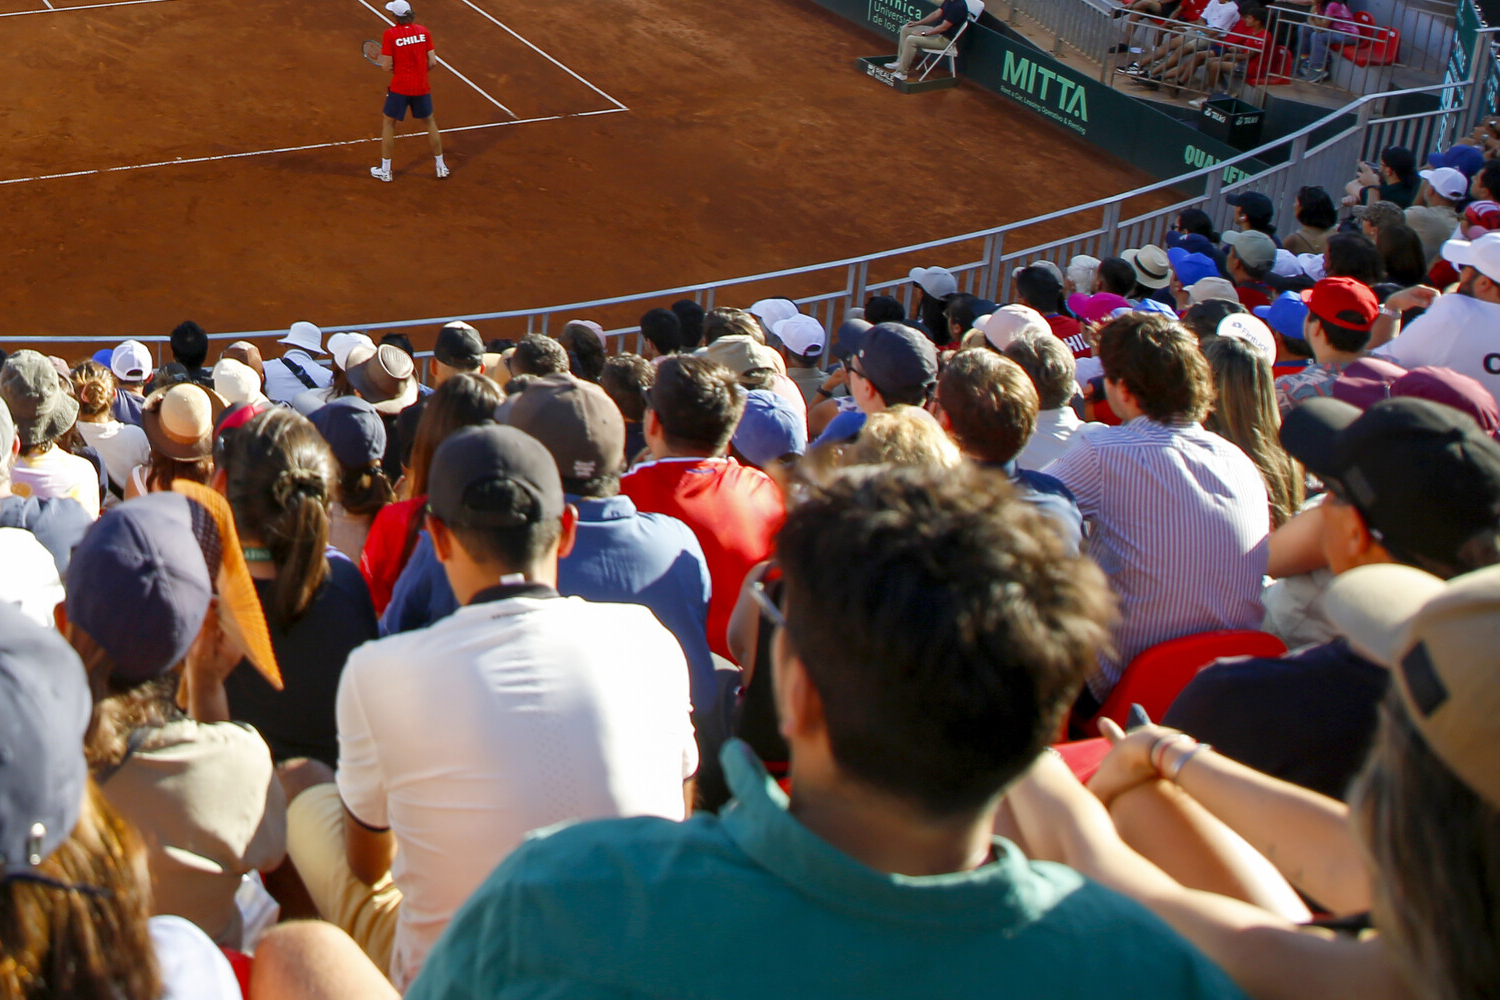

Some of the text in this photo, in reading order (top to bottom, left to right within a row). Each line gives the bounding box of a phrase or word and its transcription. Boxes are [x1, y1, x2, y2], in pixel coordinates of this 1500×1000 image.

[873, 14, 883, 26] de
[884, 19, 896, 32] los
[395, 34, 426, 47] CHILE
[1002, 50, 1088, 122] MITTA
